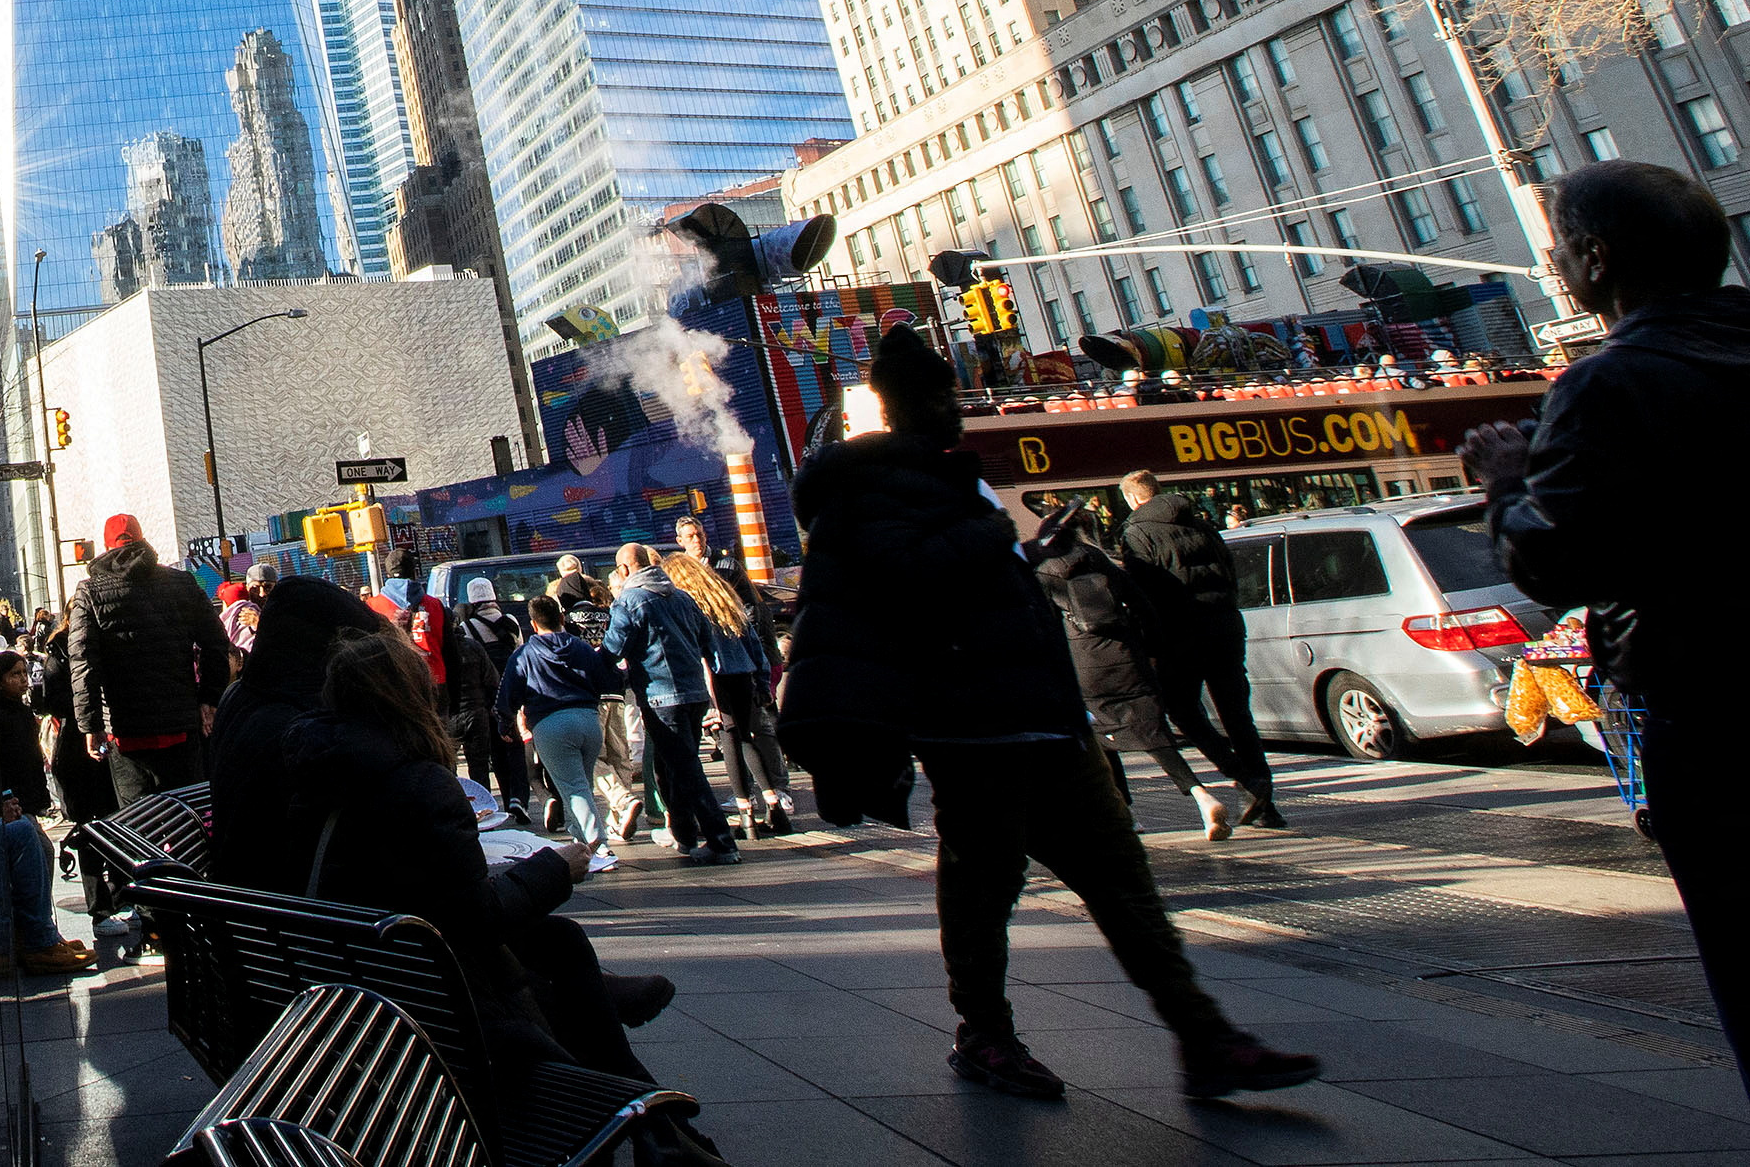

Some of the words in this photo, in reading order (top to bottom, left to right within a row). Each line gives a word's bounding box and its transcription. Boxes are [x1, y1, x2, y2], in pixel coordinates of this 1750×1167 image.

[761, 302, 810, 314] Welcome
[813, 301, 822, 309] to
[825, 297, 841, 309] the
[1544, 327, 1563, 338] ONE
[1570, 320, 1592, 332] WAY
[1571, 347, 1588, 356] ONE
[1168, 409, 1418, 463] BIGBUS.COM
[346, 467, 367, 477] ONE
[375, 465, 396, 476] WAY
